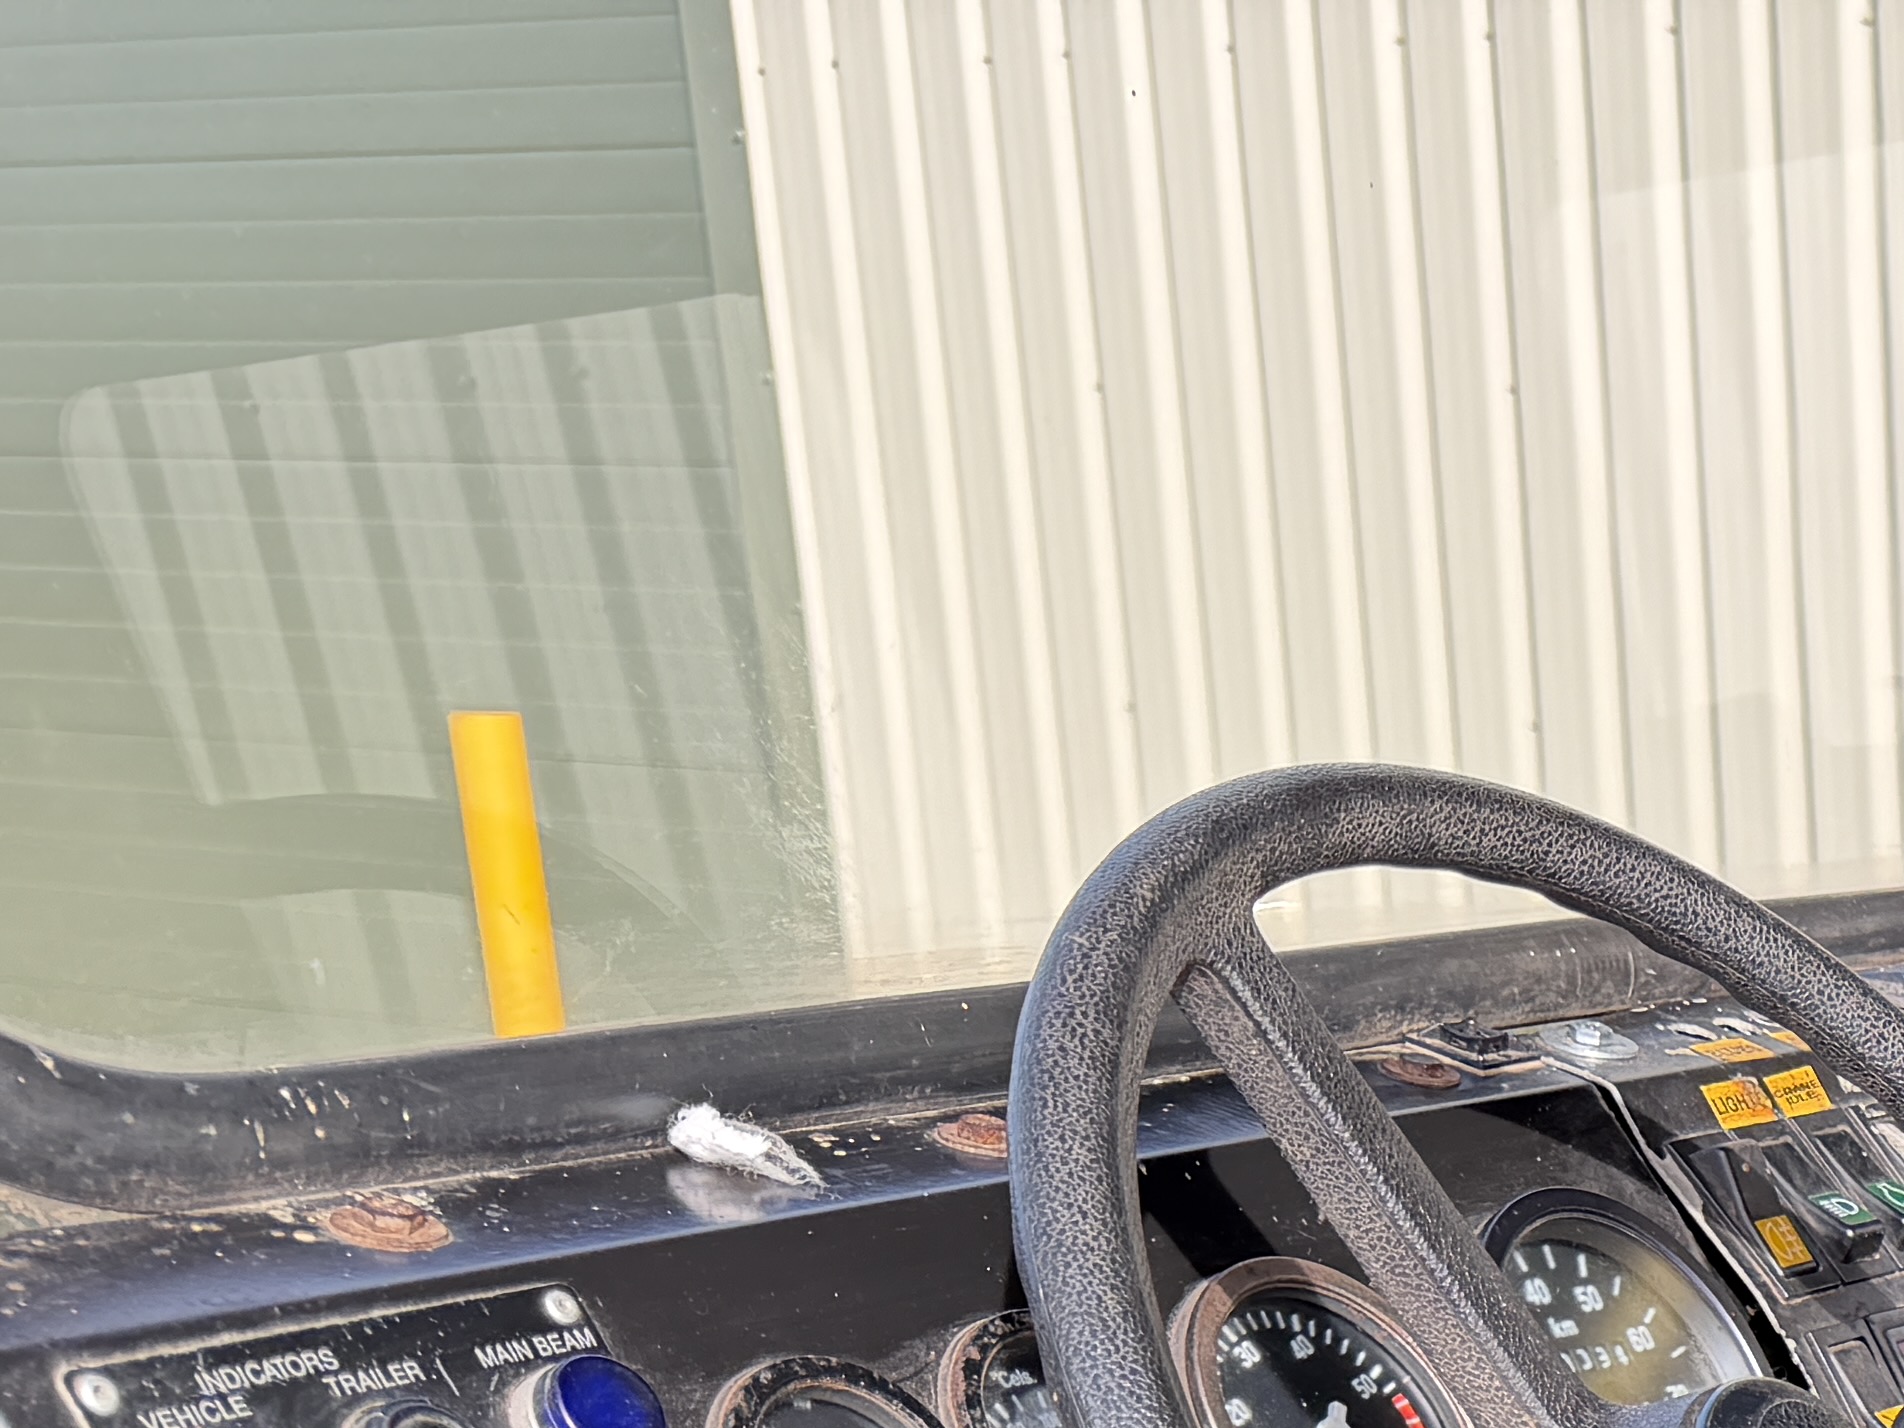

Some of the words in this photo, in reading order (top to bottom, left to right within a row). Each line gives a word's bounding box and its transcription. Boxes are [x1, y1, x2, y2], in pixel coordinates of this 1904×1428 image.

[1573, 1284, 1604, 1313] 50
[474, 1338, 535, 1369] MAIN
[533, 1326, 598, 1357] BEAM
[1290, 1335, 1316, 1360] 40
[1626, 1325, 1656, 1352] 60
[1234, 1340, 1262, 1369] 30
[194, 1347, 340, 1395] INDICATORS
[321, 1360, 426, 1397] TRAILER
[1351, 1373, 1378, 1400] 50
